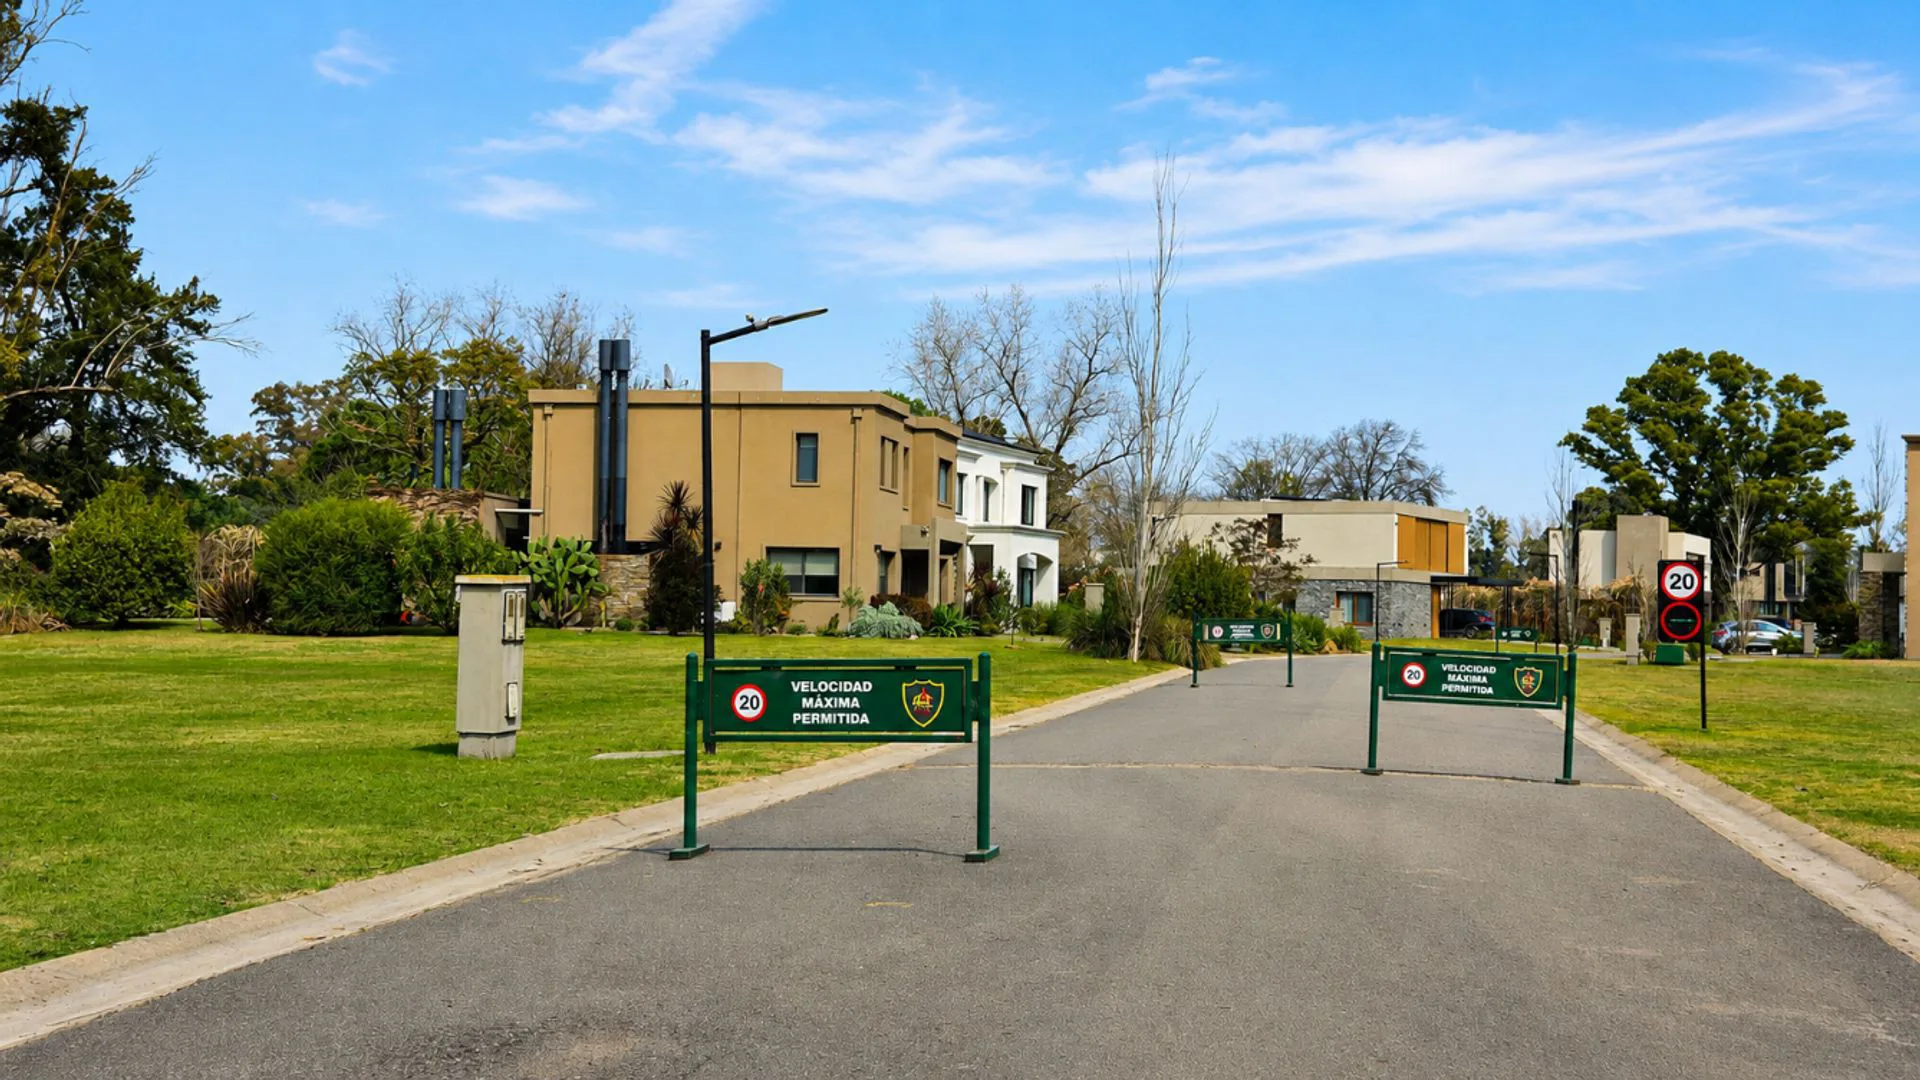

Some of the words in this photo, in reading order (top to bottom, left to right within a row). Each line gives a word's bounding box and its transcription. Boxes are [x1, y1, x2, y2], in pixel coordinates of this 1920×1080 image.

[1669, 573, 1695, 590] 20
[1407, 669, 1421, 680] 20
[1442, 664, 1496, 674] VELOCIDAD
[791, 681, 873, 693] VELOCIDAD
[1442, 684, 1494, 694] PERMITIDA
[739, 694, 760, 710] 20
[802, 694, 860, 708] MÁXIMA
[793, 712, 870, 724] PERMITIDA
